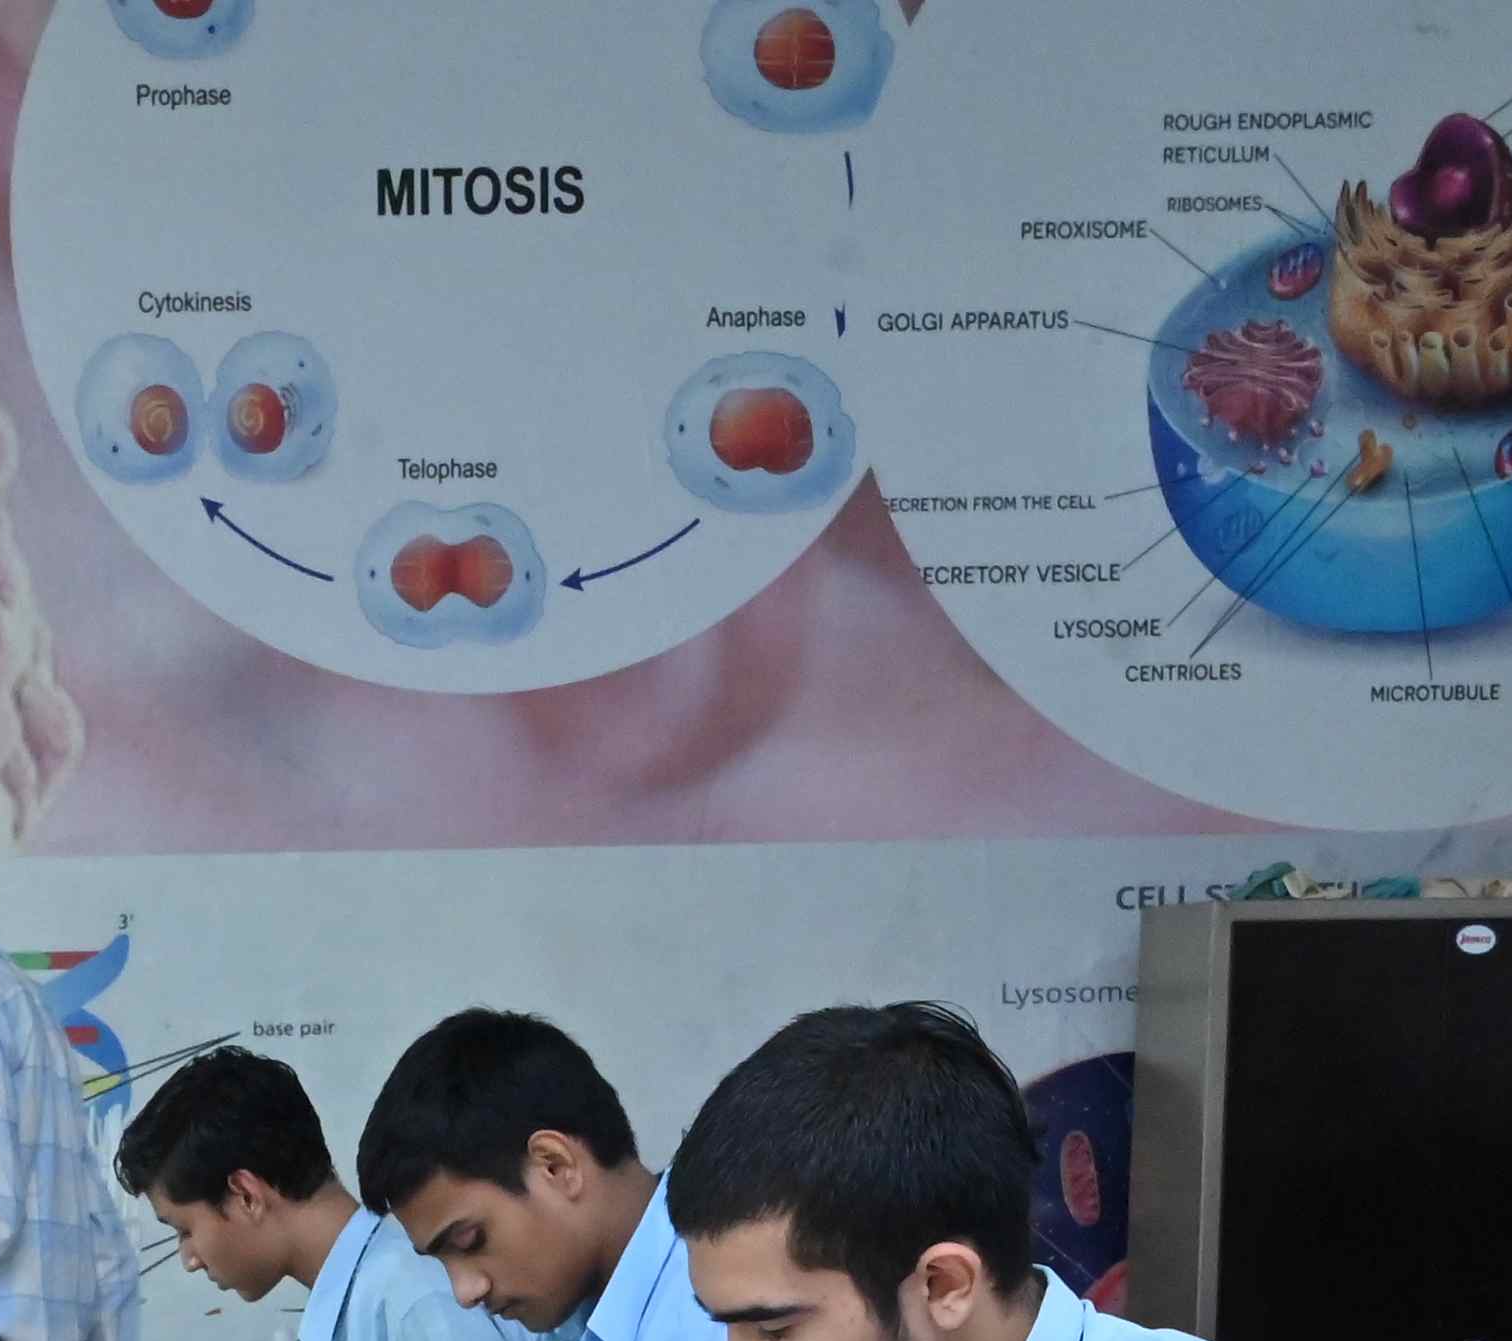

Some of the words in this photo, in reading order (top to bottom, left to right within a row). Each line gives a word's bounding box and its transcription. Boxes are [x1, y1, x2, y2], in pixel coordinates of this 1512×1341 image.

[136, 83, 232, 110] Prophase
[1163, 113, 1232, 131] ROUGH
[1238, 111, 1373, 130] ENDOPLASMIC
[1163, 146, 1270, 164] RETICULUM
[376, 165, 585, 217] MITOSIS
[1167, 196, 1263, 213] RIBOSOMES
[1020, 220, 1149, 241] PEROXISOME
[137, 288, 253, 318] Cytokinesis
[705, 304, 806, 333] Anaphase
[877, 312, 944, 332] GOLGI
[950, 309, 1069, 330] APPARATUS
[398, 458, 497, 482] Telophase
[880, 498, 969, 514] ECRETION
[972, 496, 1017, 512] FROM
[1021, 496, 1053, 511] THE
[1056, 494, 1096, 510] CELL
[916, 565, 1030, 585] ECRETORY
[1036, 564, 1121, 583] VESICLE
[1053, 618, 1162, 639] LYSOSOME
[1124, 663, 1242, 683] CENTRIOLES
[1370, 683, 1501, 703] MICROTUBULE
[253, 1015, 293, 1037] base
[299, 1016, 336, 1040] pair
